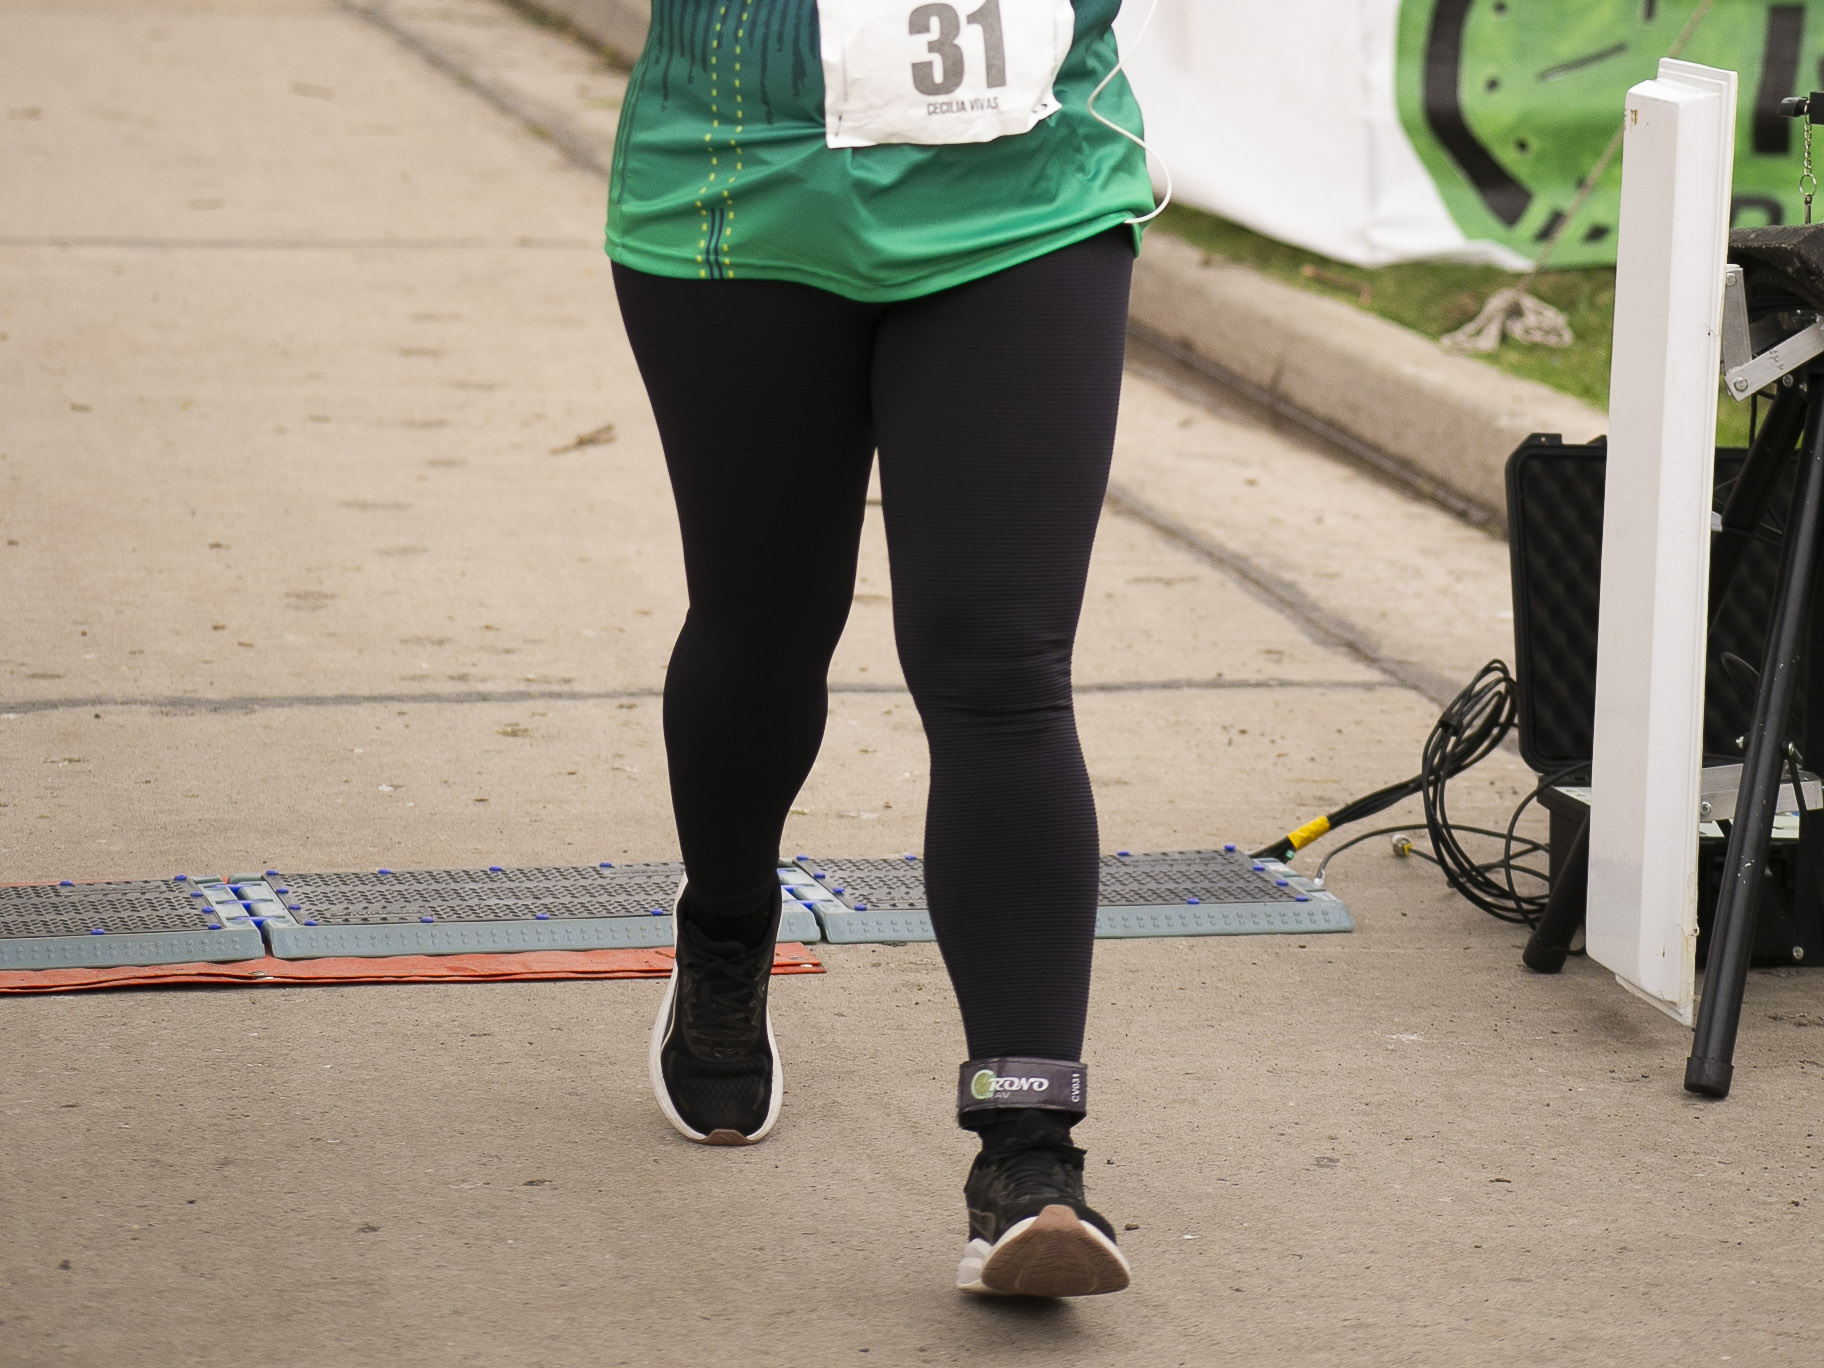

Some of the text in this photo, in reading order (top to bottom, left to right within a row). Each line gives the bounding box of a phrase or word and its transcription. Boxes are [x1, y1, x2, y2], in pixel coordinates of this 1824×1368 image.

[927, 96, 999, 116] CECILIA VIVAS
[1071, 1073, 1081, 1103] CV031
